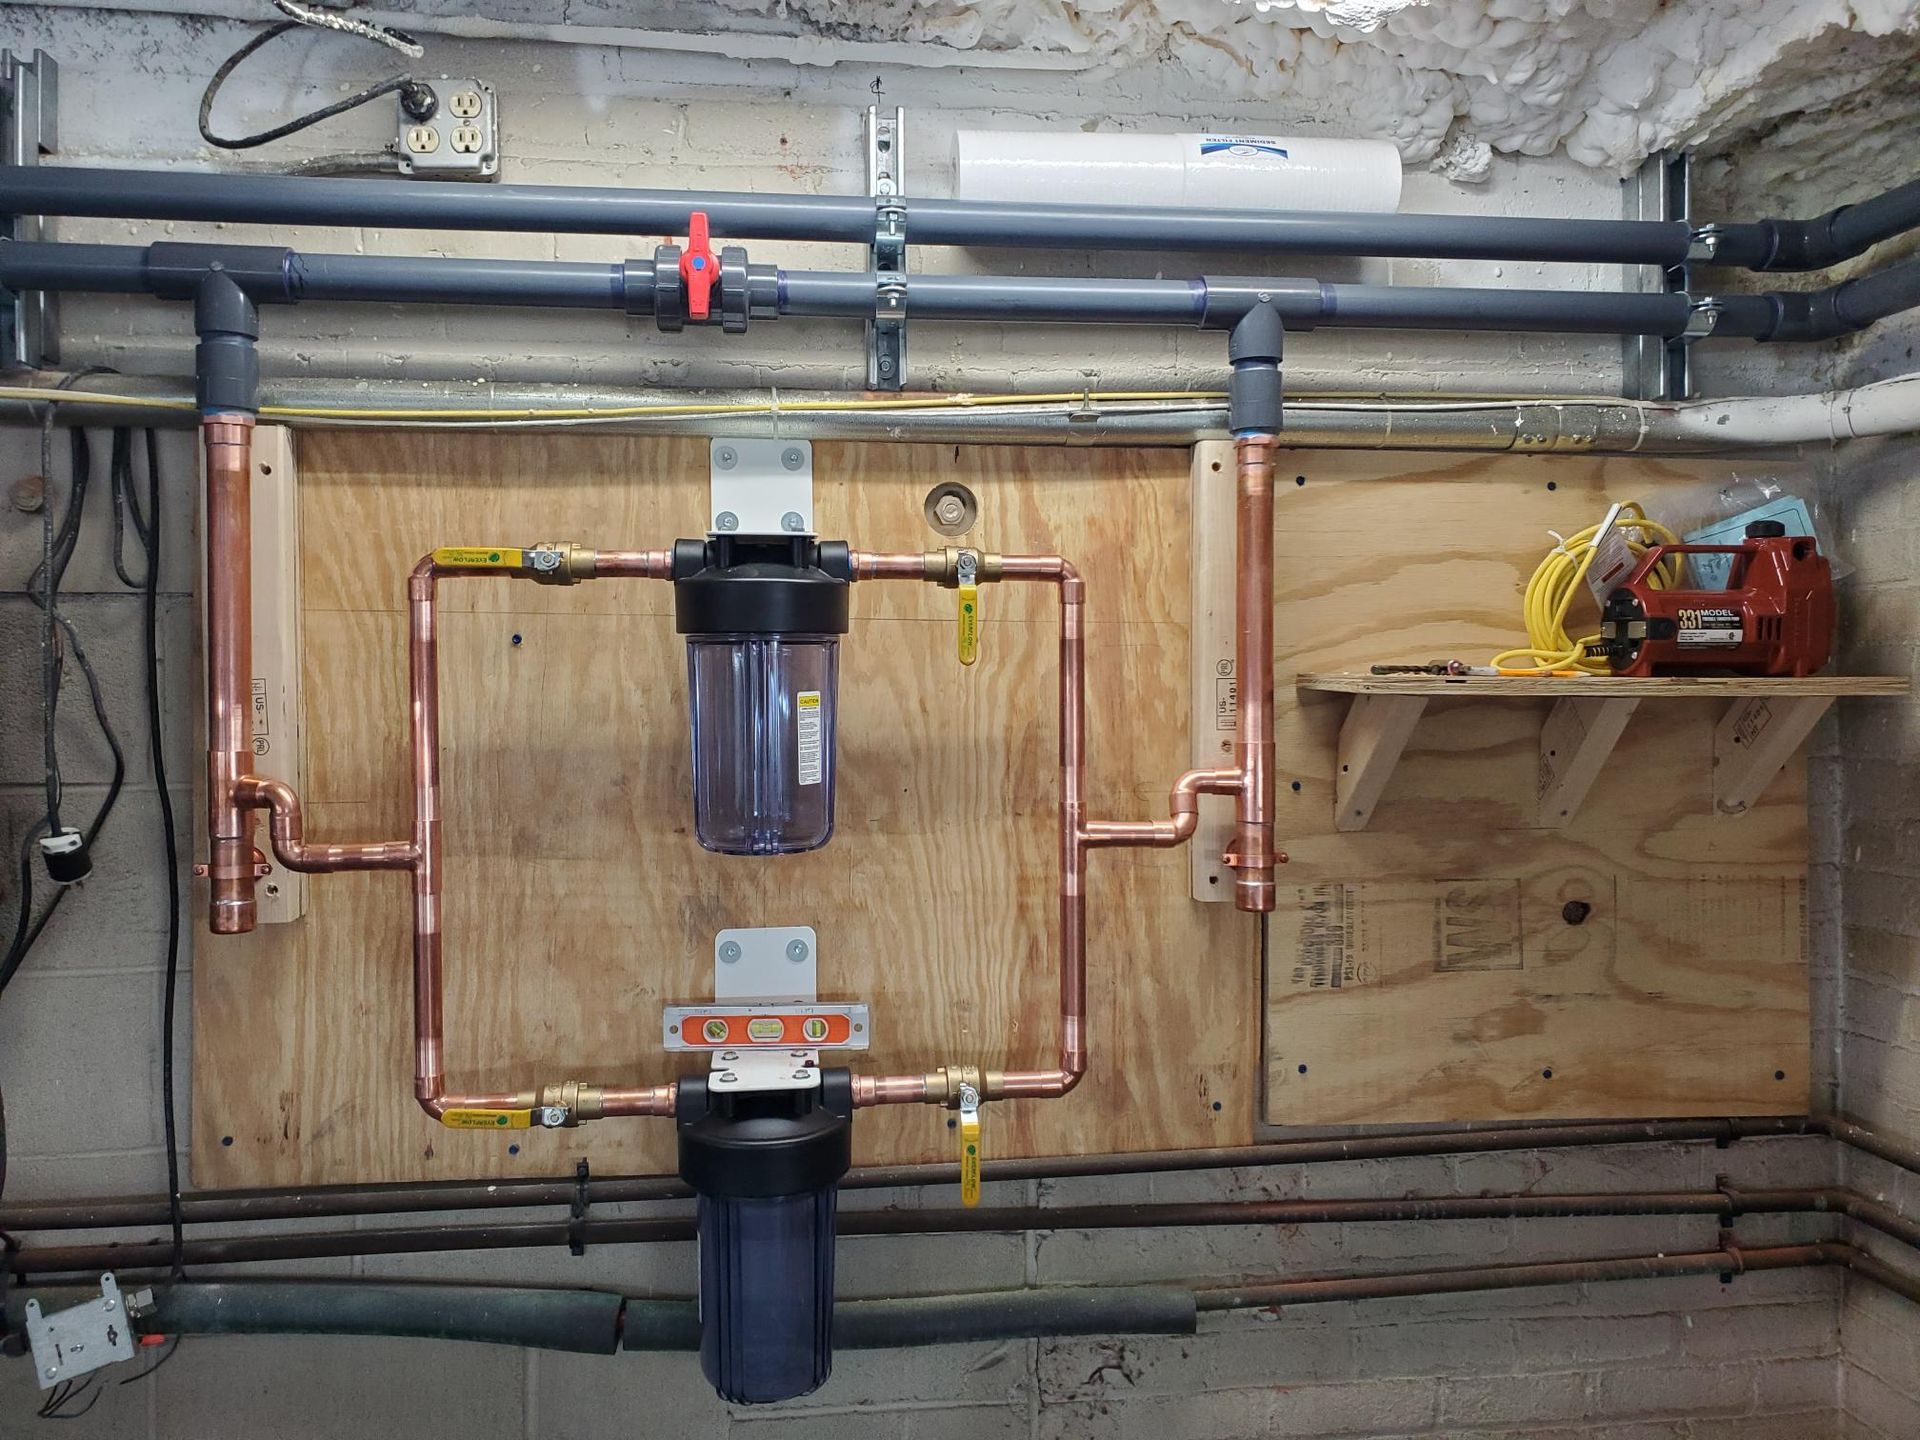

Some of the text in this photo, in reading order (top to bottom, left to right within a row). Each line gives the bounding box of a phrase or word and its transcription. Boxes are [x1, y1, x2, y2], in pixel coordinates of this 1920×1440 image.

[1678, 609, 1702, 629] 331
[255, 697, 264, 715] US-
[1219, 697, 1227, 713] US-
[256, 740, 264, 754] PRL
